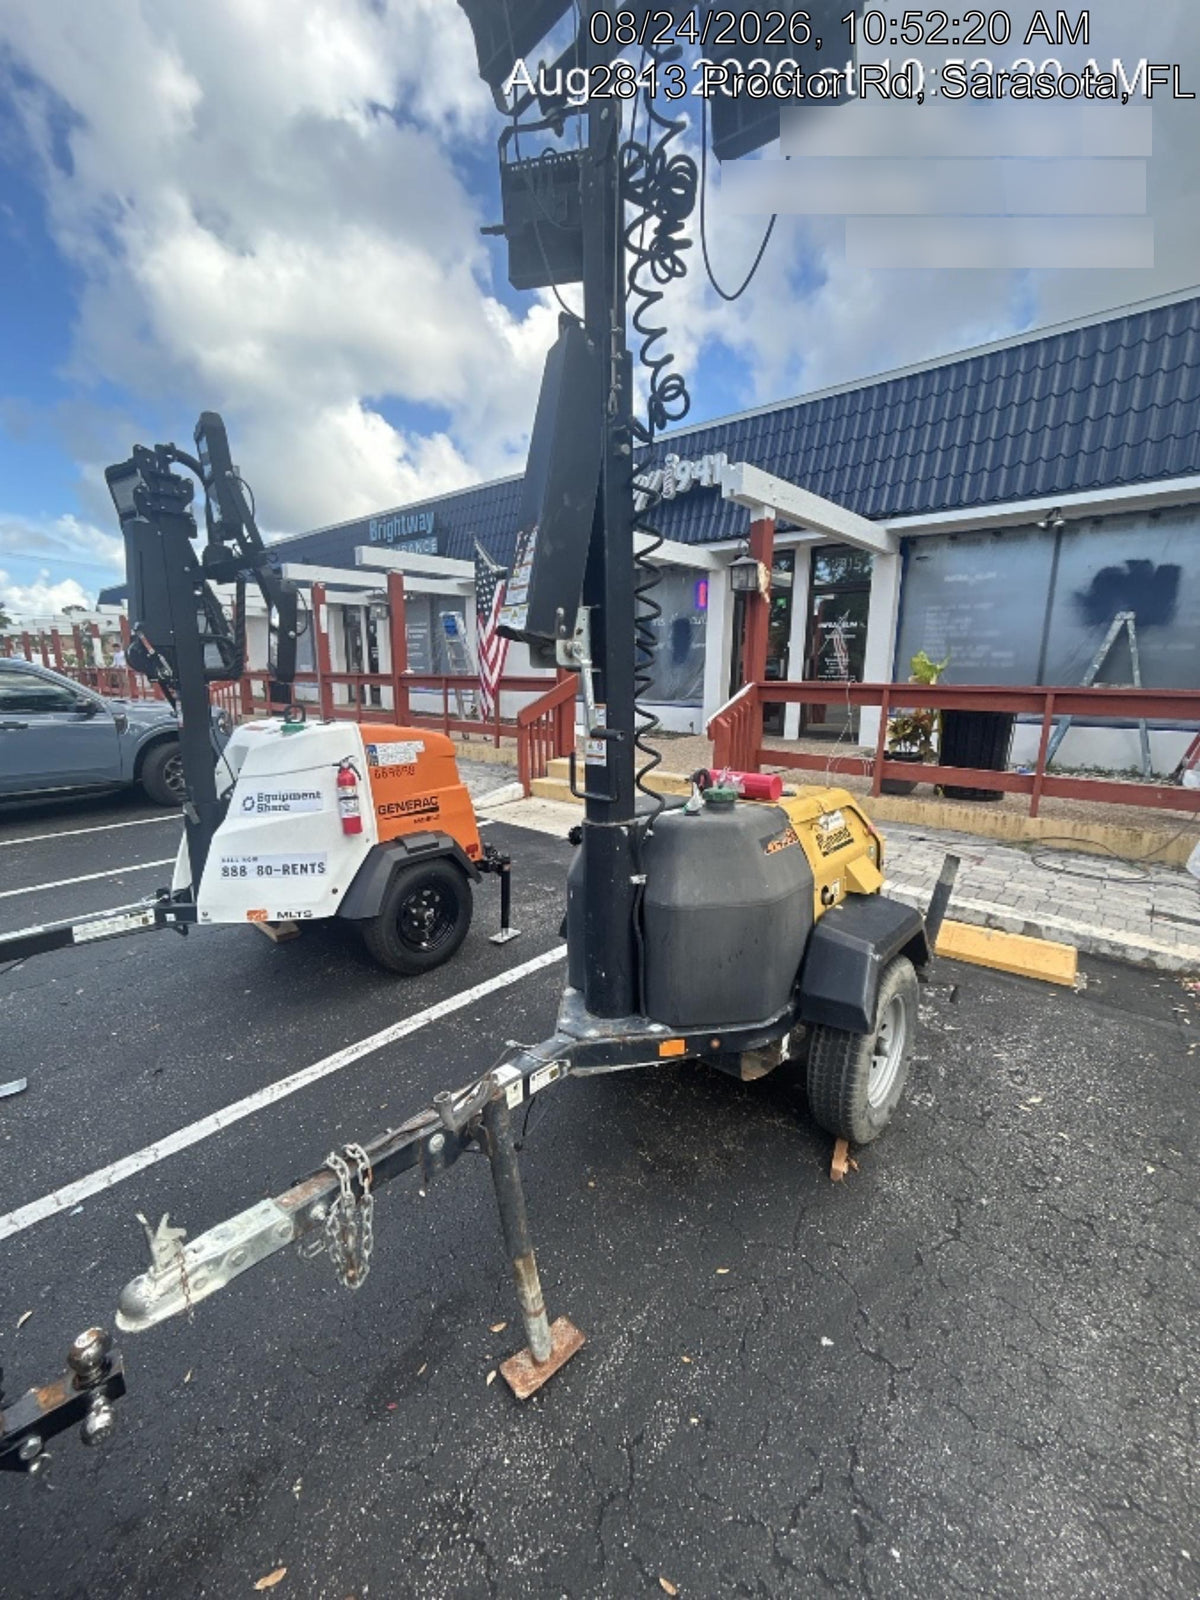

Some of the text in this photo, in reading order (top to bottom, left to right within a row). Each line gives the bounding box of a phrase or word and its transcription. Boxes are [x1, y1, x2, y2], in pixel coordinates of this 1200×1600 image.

[369, 511, 435, 543] Brightway
[257, 790, 322, 803] Equipment
[257, 803, 291, 813] Share
[378, 796, 439, 815] GENERAC
[221, 861, 326, 878] 888 80-RENTS
